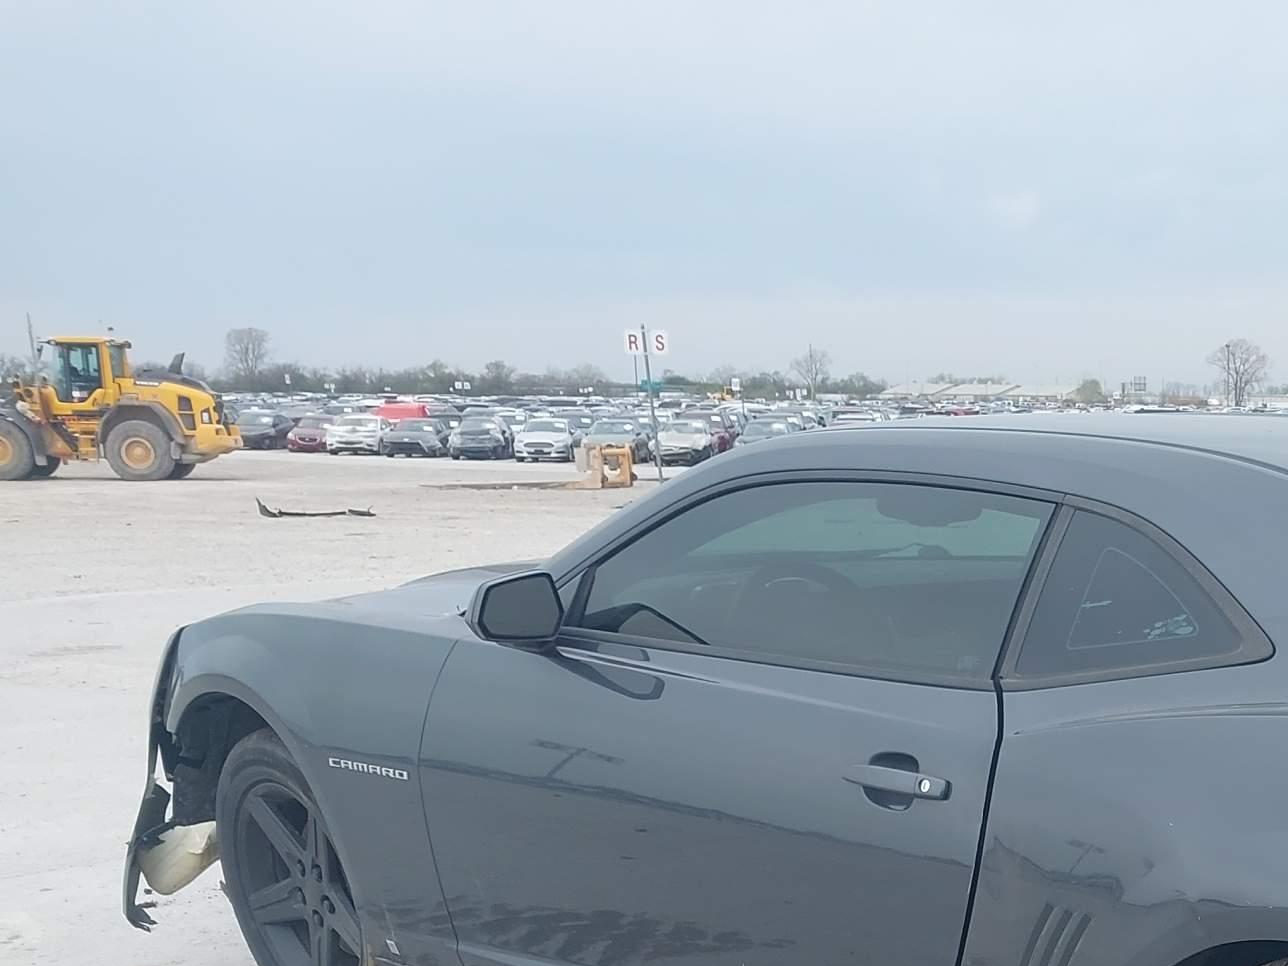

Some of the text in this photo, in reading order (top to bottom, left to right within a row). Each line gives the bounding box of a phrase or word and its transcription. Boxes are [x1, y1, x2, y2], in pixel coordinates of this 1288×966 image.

[628, 334, 639, 351] R
[655, 334, 665, 351] S
[328, 757, 409, 781] CAMARO
